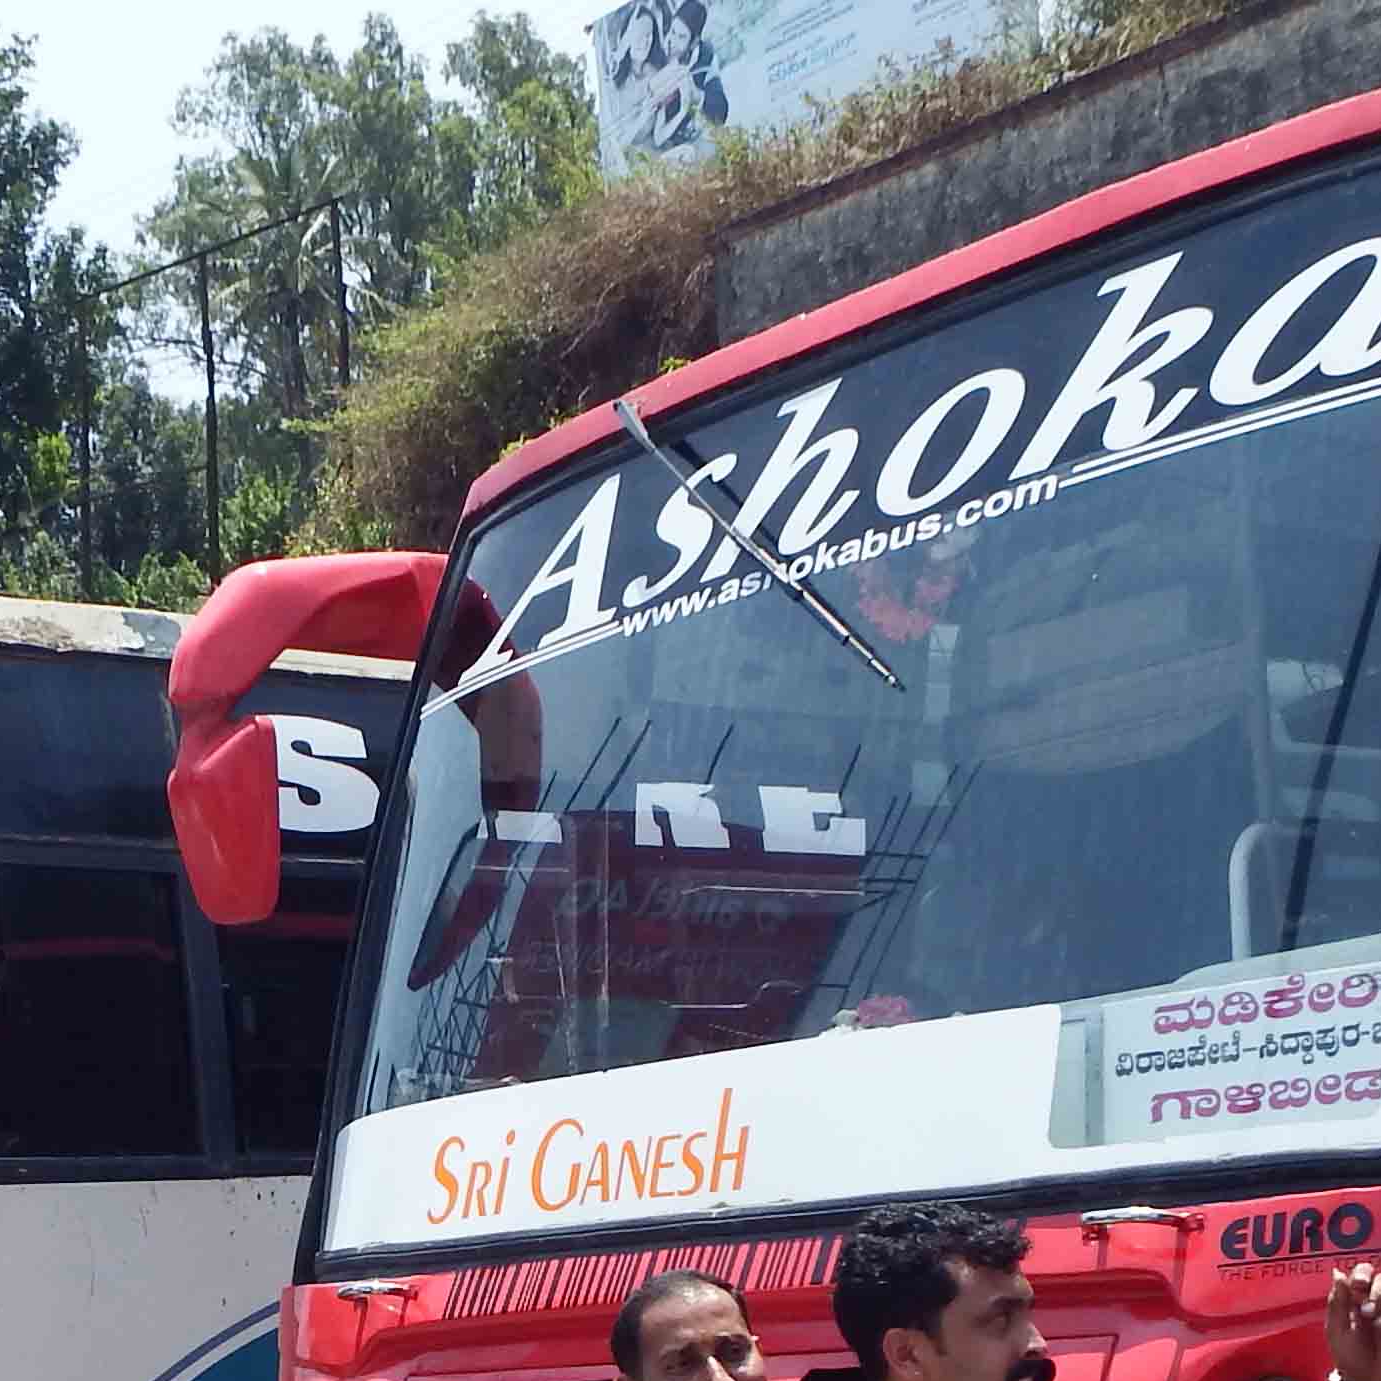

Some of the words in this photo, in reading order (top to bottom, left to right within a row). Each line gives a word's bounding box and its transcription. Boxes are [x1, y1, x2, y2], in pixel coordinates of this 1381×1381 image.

[621, 474, 1060, 638] www.ashokabus.com
[1152, 972, 1380, 1036] ಮಡಿಕೇರಿ
[1220, 1202, 1374, 1260] EURO
[1219, 1267, 1253, 1282] THE
[1260, 1259, 1324, 1281] FORCE
